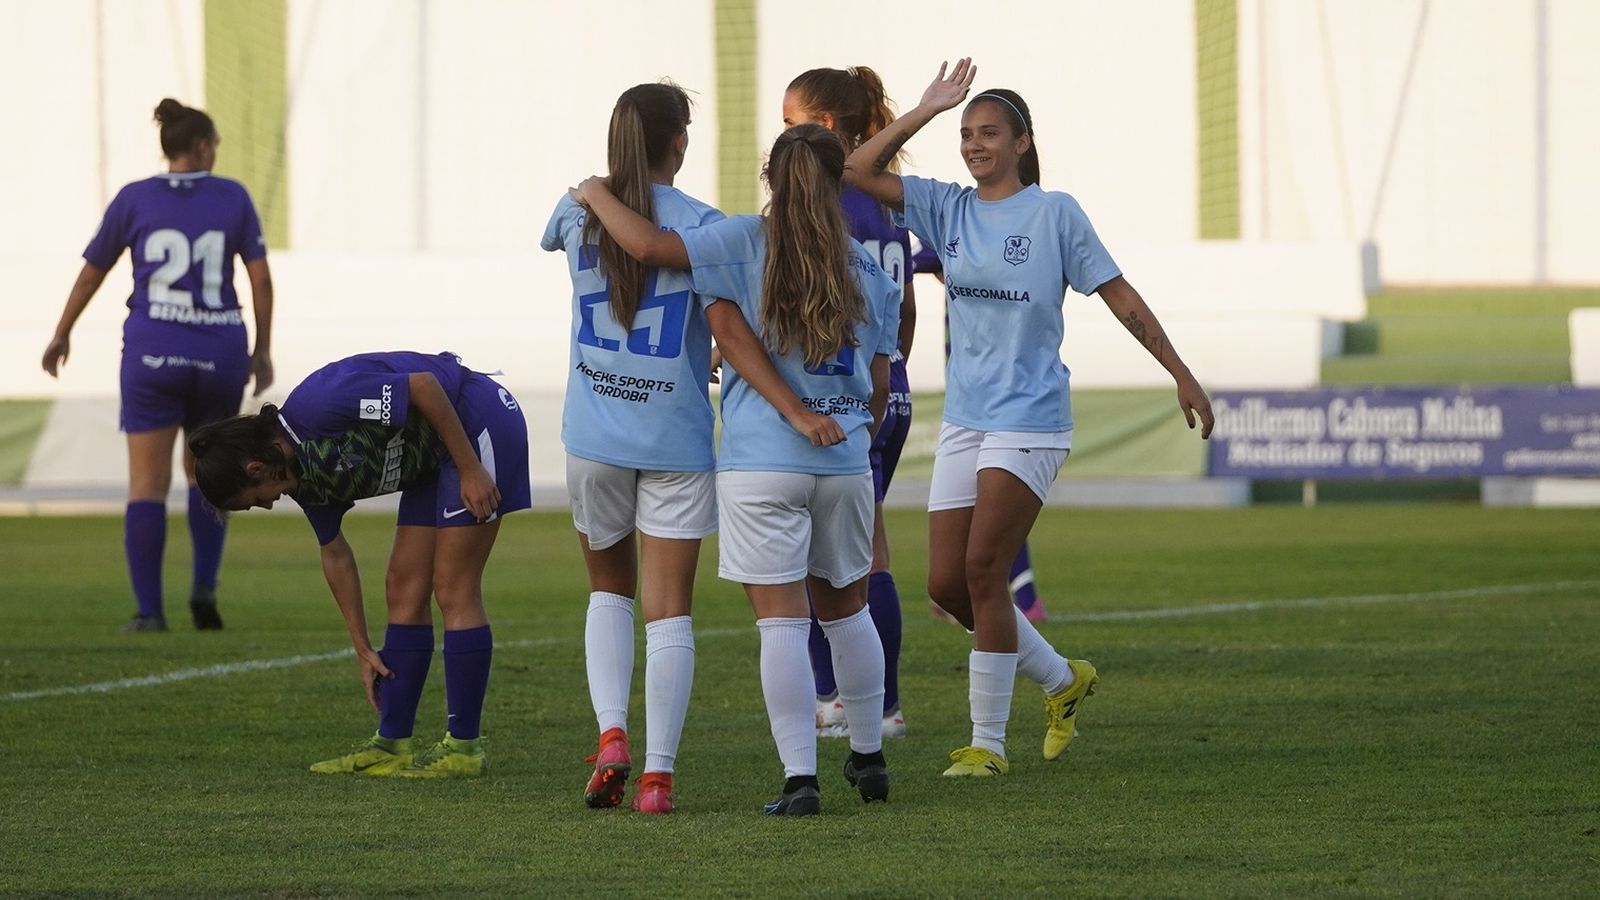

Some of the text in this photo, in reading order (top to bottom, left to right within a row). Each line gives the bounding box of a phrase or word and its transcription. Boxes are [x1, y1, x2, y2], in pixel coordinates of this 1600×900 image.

[145, 229, 225, 309] 21
[954, 286, 1030, 302] SERCOMALLA
[618, 376, 675, 393] SPORTS
